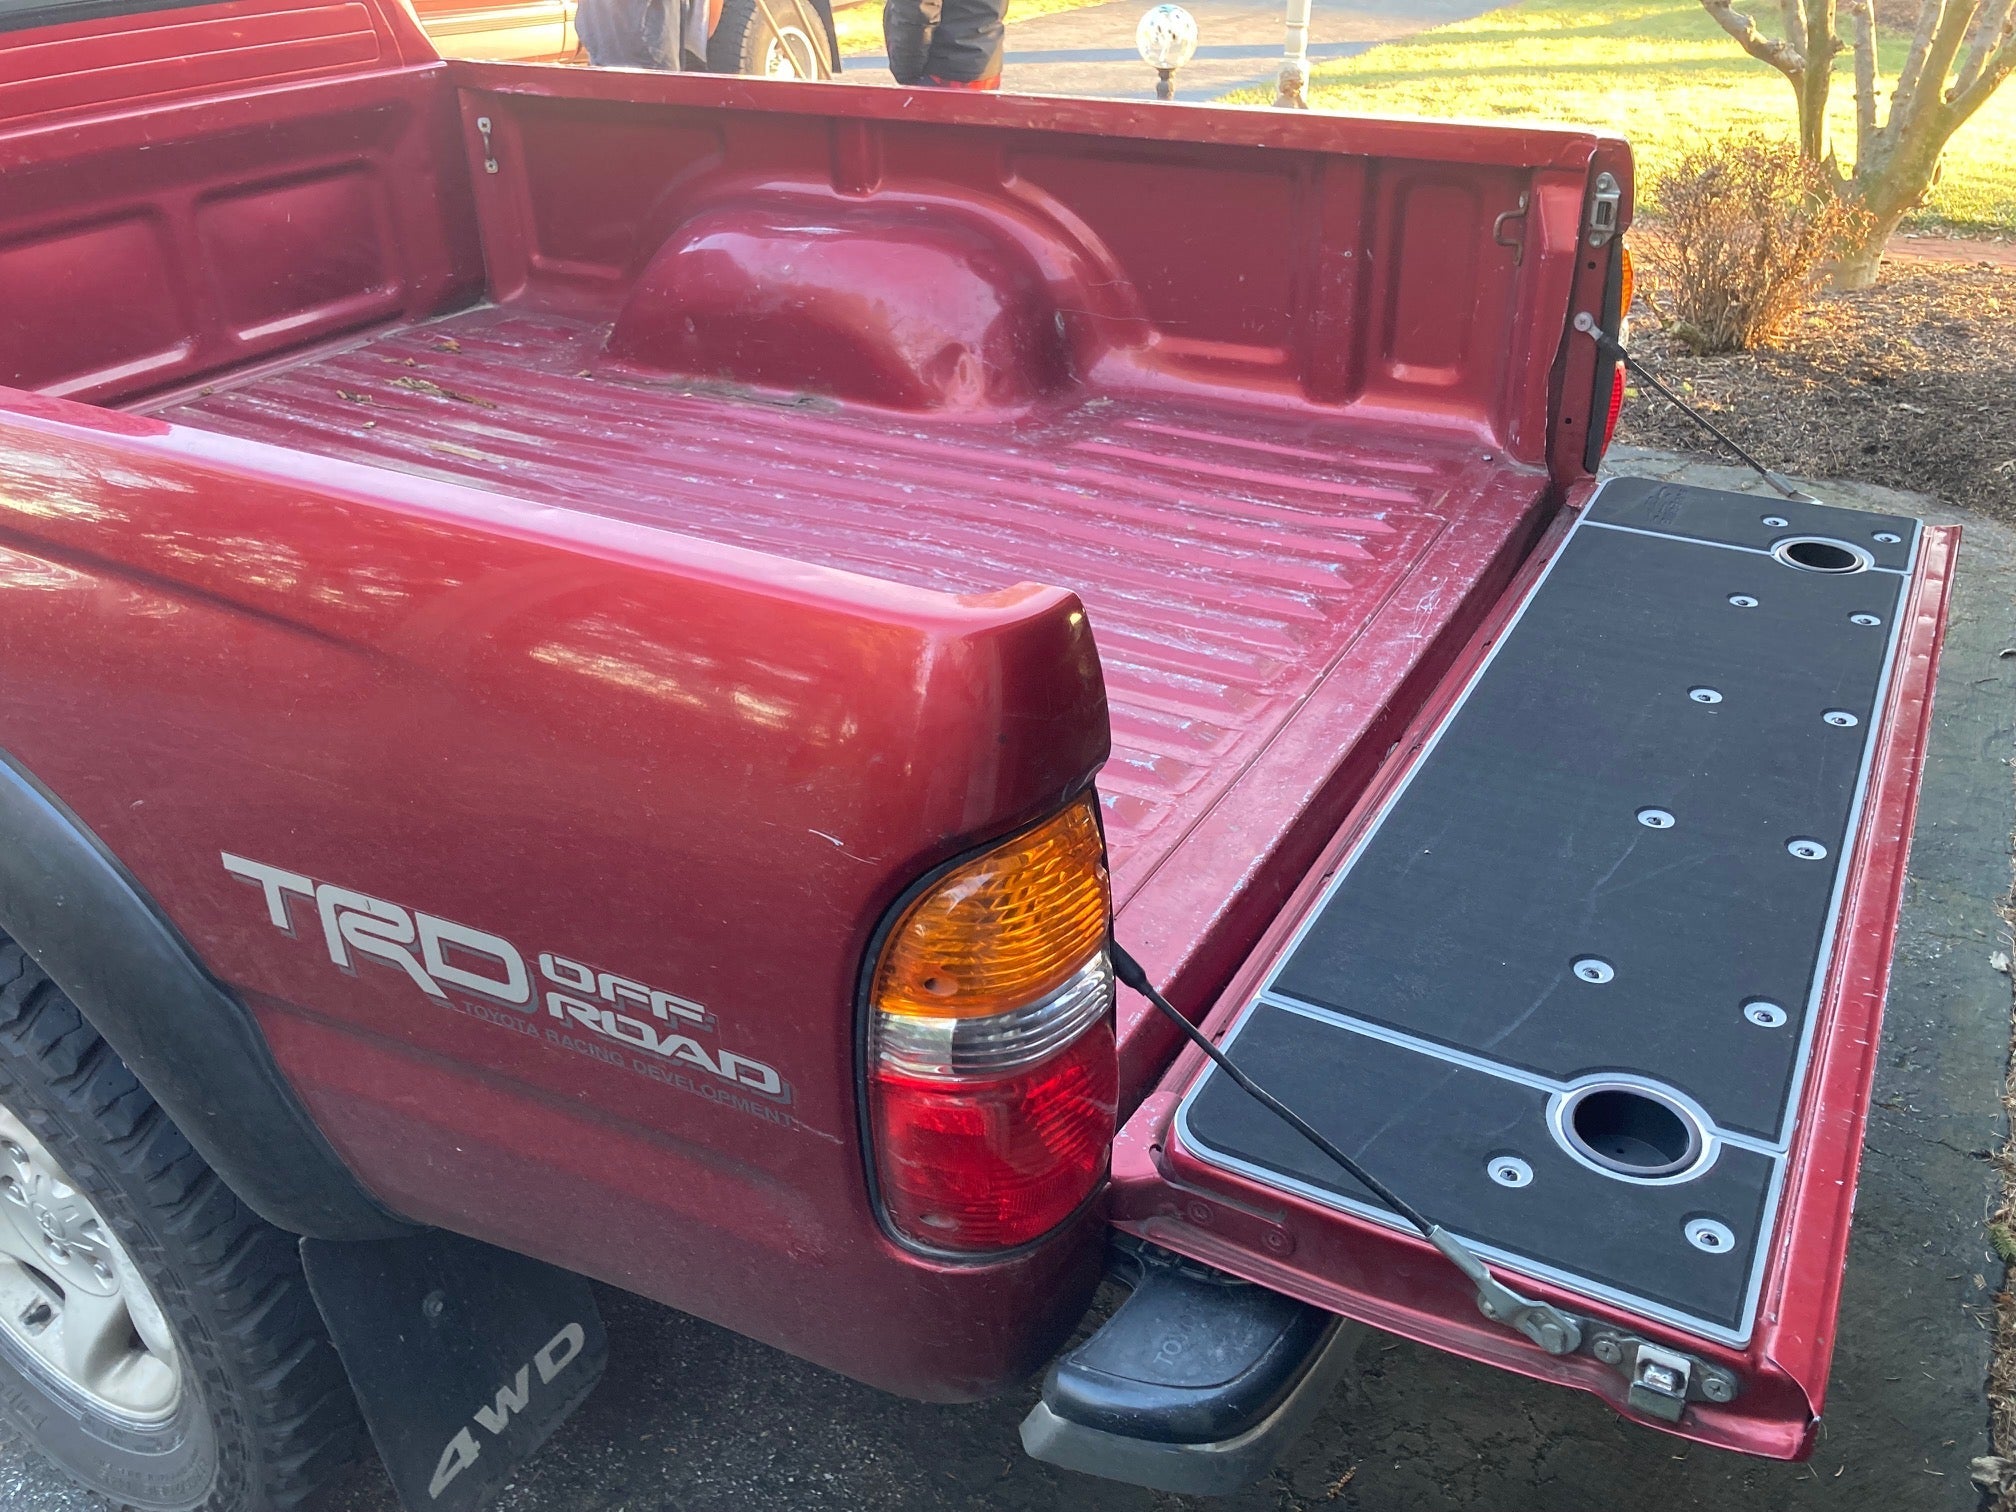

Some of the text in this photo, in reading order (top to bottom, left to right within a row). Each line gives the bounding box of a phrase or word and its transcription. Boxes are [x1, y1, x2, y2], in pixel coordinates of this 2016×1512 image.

[220, 850, 531, 1003] TRD
[538, 953, 709, 1026] OFF
[545, 991, 785, 1098] ROAD
[463, 1001, 794, 1127] TOYOTA RACING DEVELOPMENT
[1152, 1295, 1202, 1366] TOYO
[428, 1322, 585, 1500] 4WD
